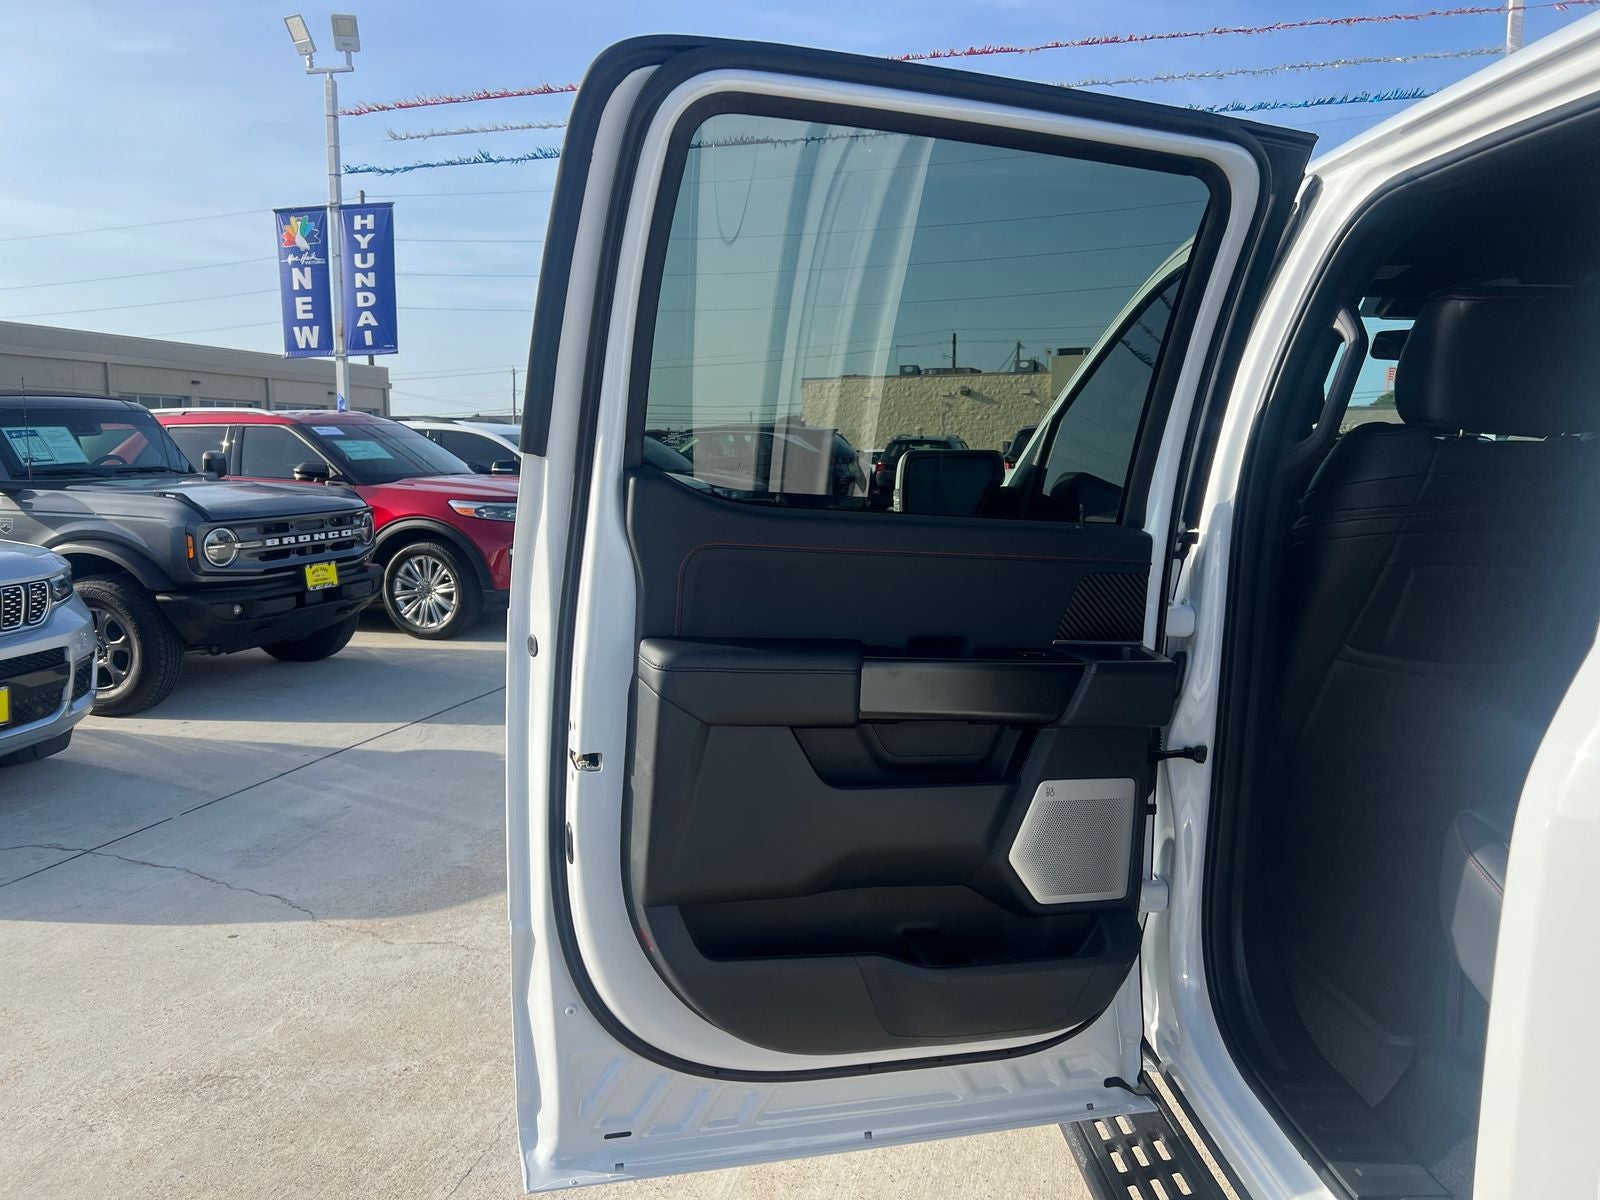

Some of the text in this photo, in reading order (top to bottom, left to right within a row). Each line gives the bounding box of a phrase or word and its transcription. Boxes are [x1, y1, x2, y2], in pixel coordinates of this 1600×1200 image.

[291, 266, 320, 349] NEW
[353, 214, 378, 346] HYUNDAI
[265, 529, 352, 547] BRONCO
